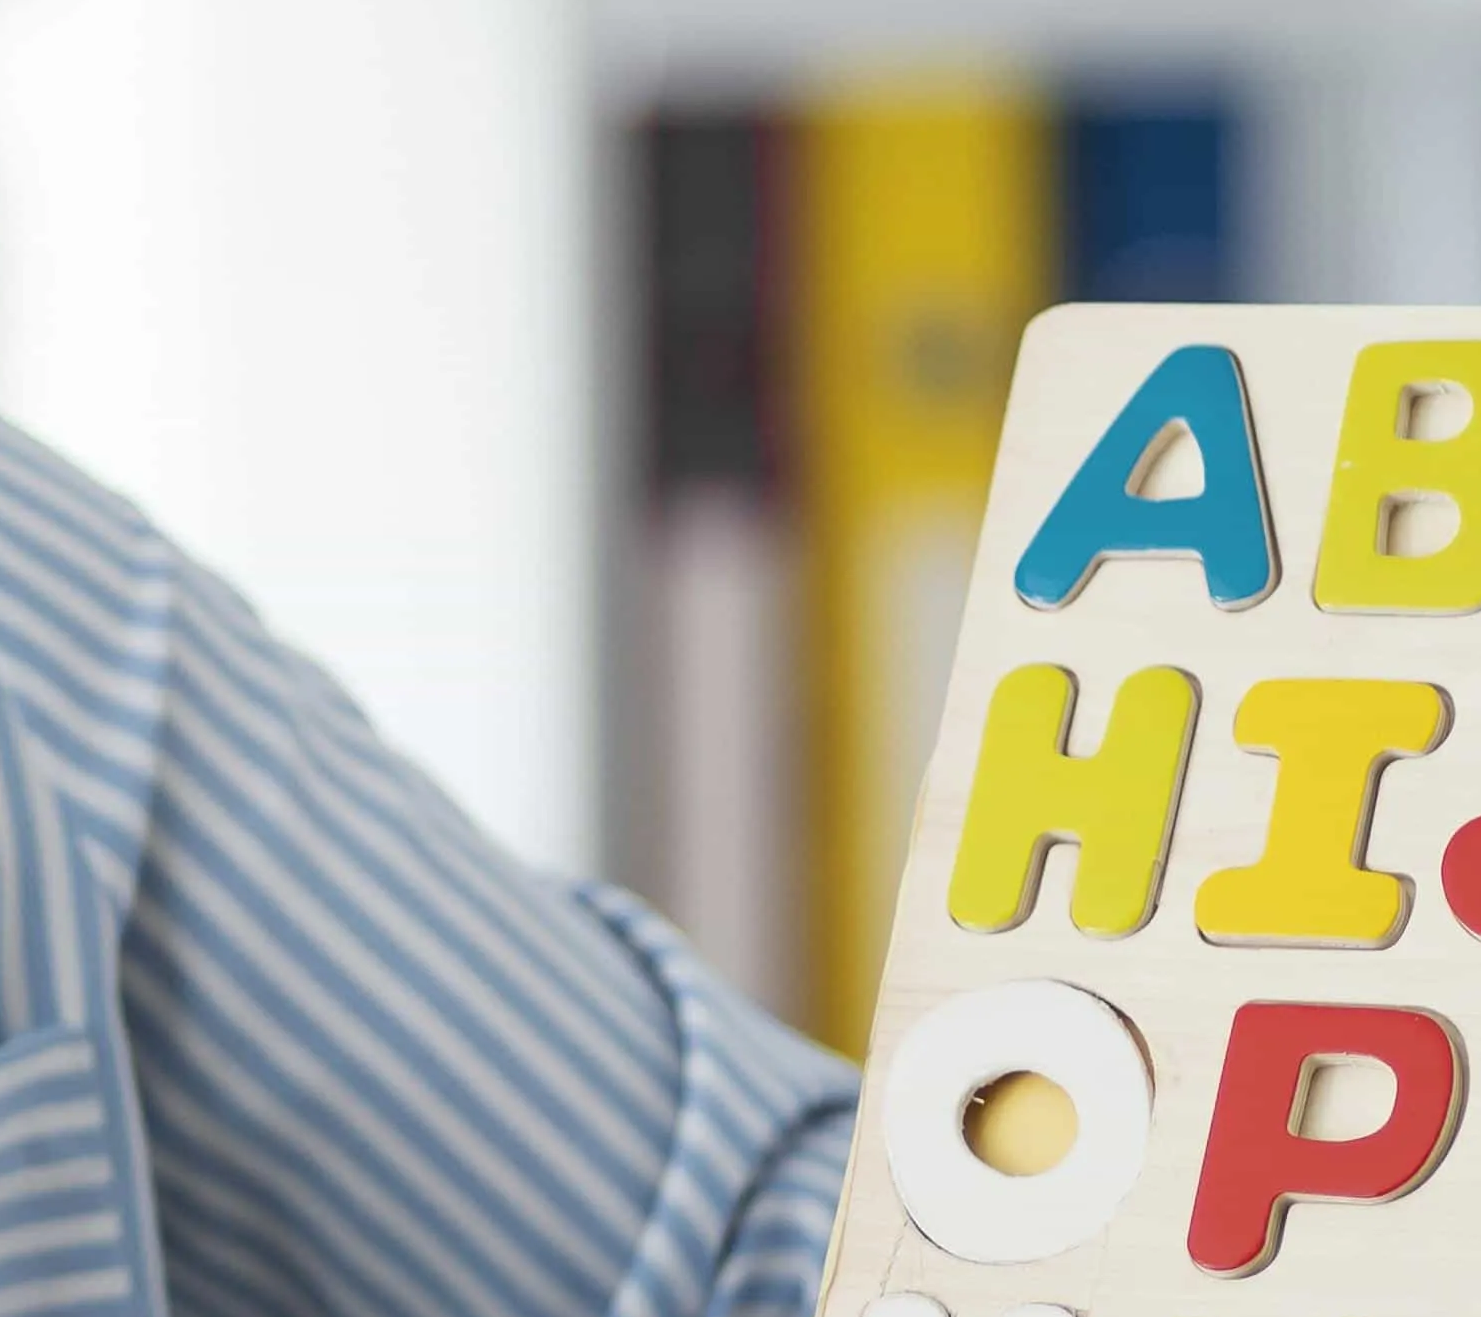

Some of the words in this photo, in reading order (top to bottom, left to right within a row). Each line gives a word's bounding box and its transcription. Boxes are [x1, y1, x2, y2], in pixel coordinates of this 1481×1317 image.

[1016, 345, 1272, 607] A
[949, 664, 1197, 935] H
[1194, 678, 1447, 947] I
[883, 979, 1154, 1264] O
[1187, 1003, 1461, 1274] P
